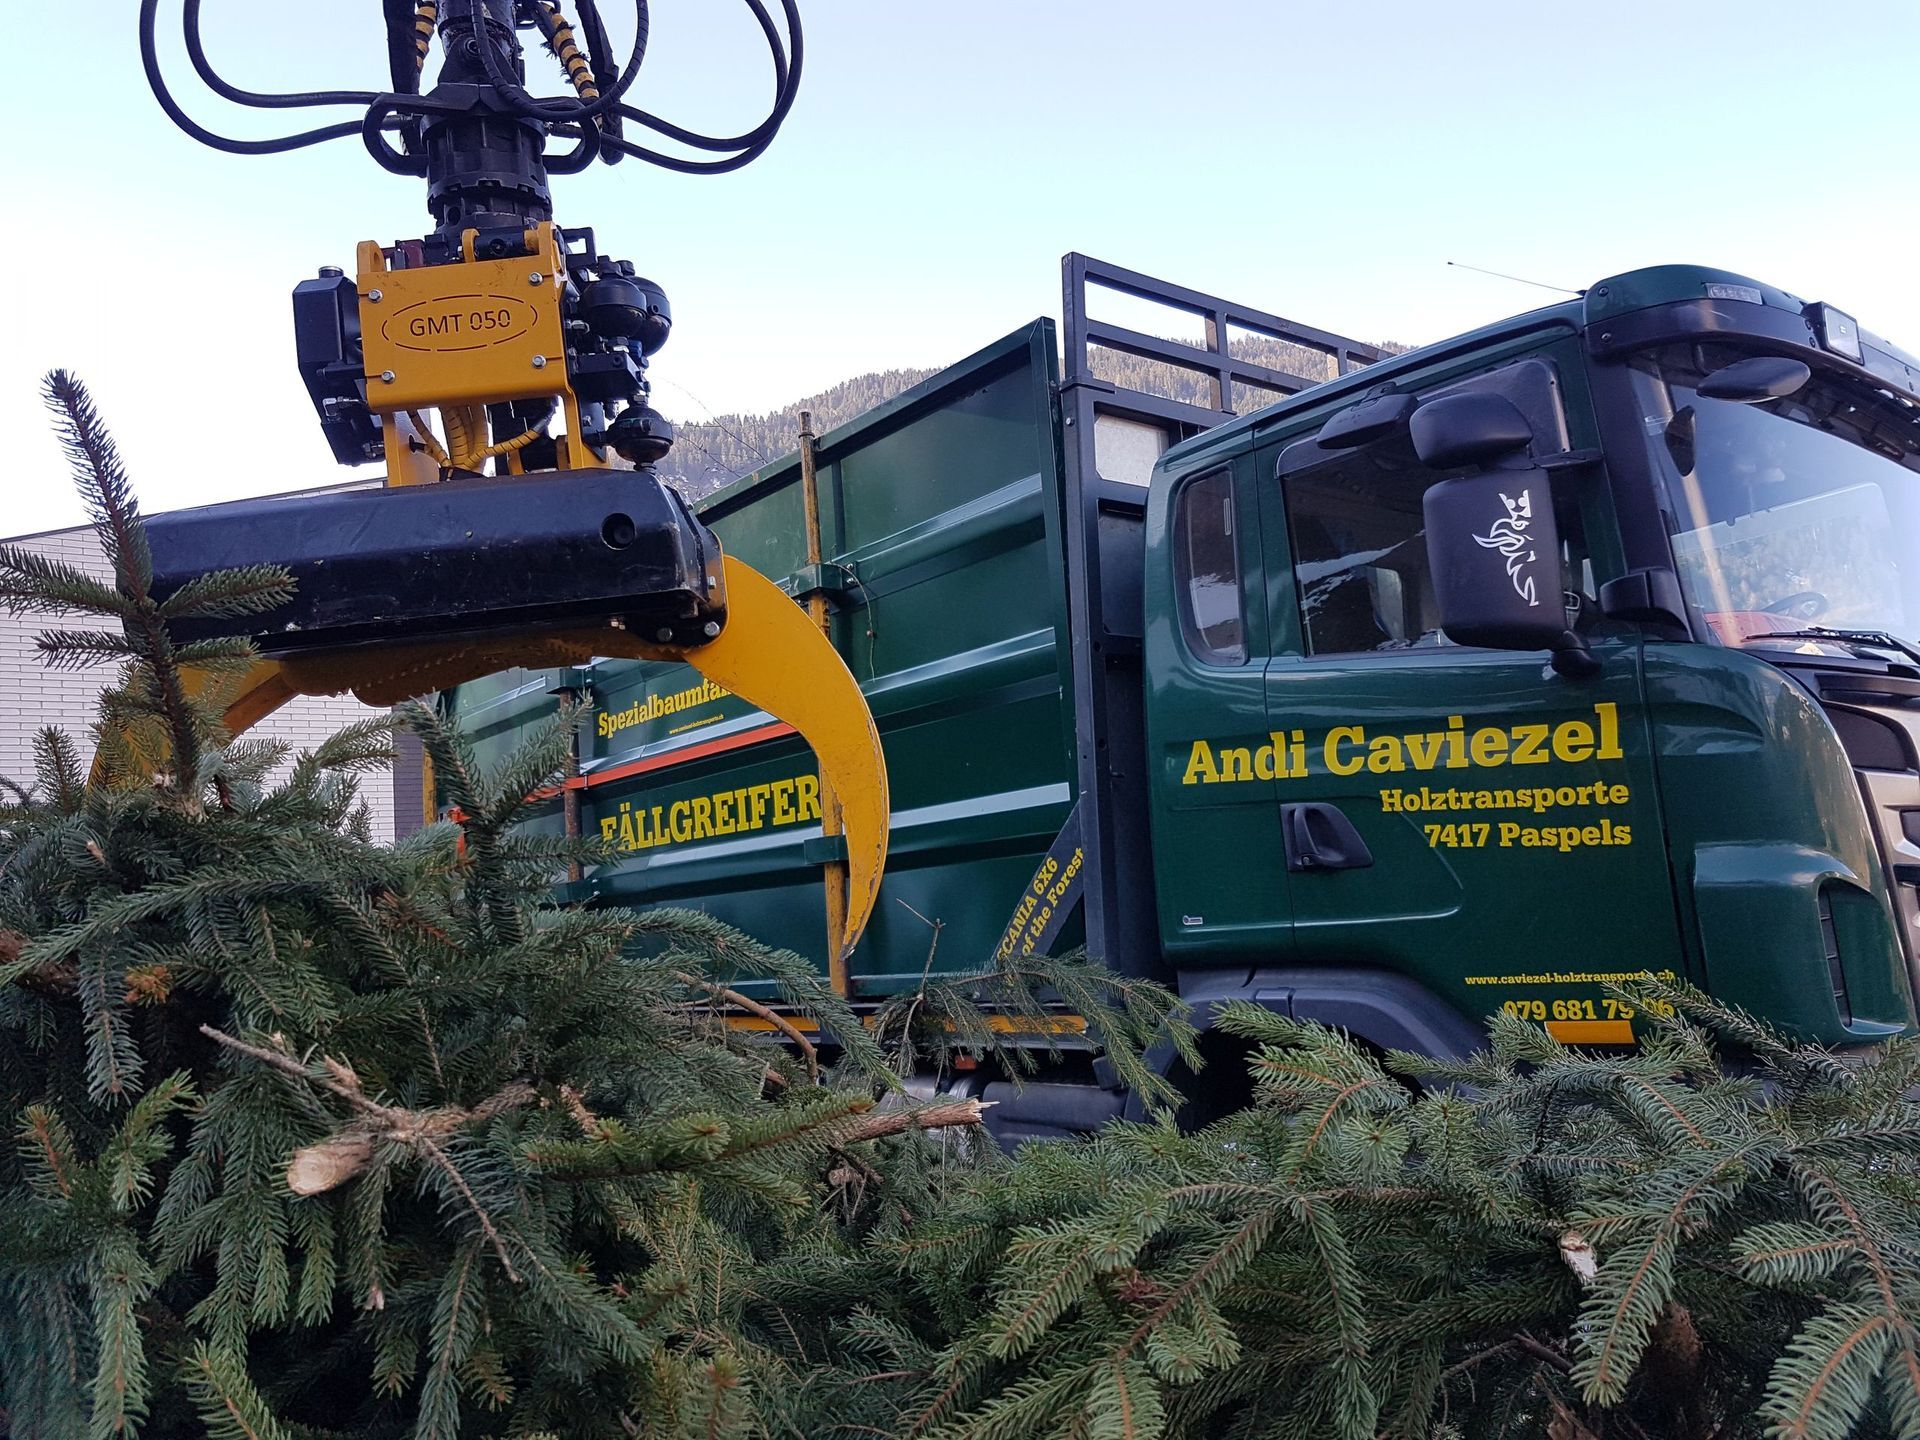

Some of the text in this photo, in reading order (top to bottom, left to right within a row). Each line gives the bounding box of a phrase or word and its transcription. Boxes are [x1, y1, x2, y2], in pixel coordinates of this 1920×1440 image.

[409, 309, 511, 337] GMT 050
[598, 678, 732, 739] Spezialbaumfä
[1182, 702, 1624, 785] Andi Caviezel
[1380, 780, 1630, 813] Holztransporte
[600, 774, 823, 855] FÄLLGREIFER
[1424, 819, 1632, 852] 7417 Paspels
[1022, 847, 1084, 956] of the Forest
[1464, 969, 1675, 985] www.caviezel-holztransport.ch
[1503, 1000, 1547, 1020] 079
[1552, 1000, 1597, 1020] 681
[1602, 999, 1635, 1019] 79
